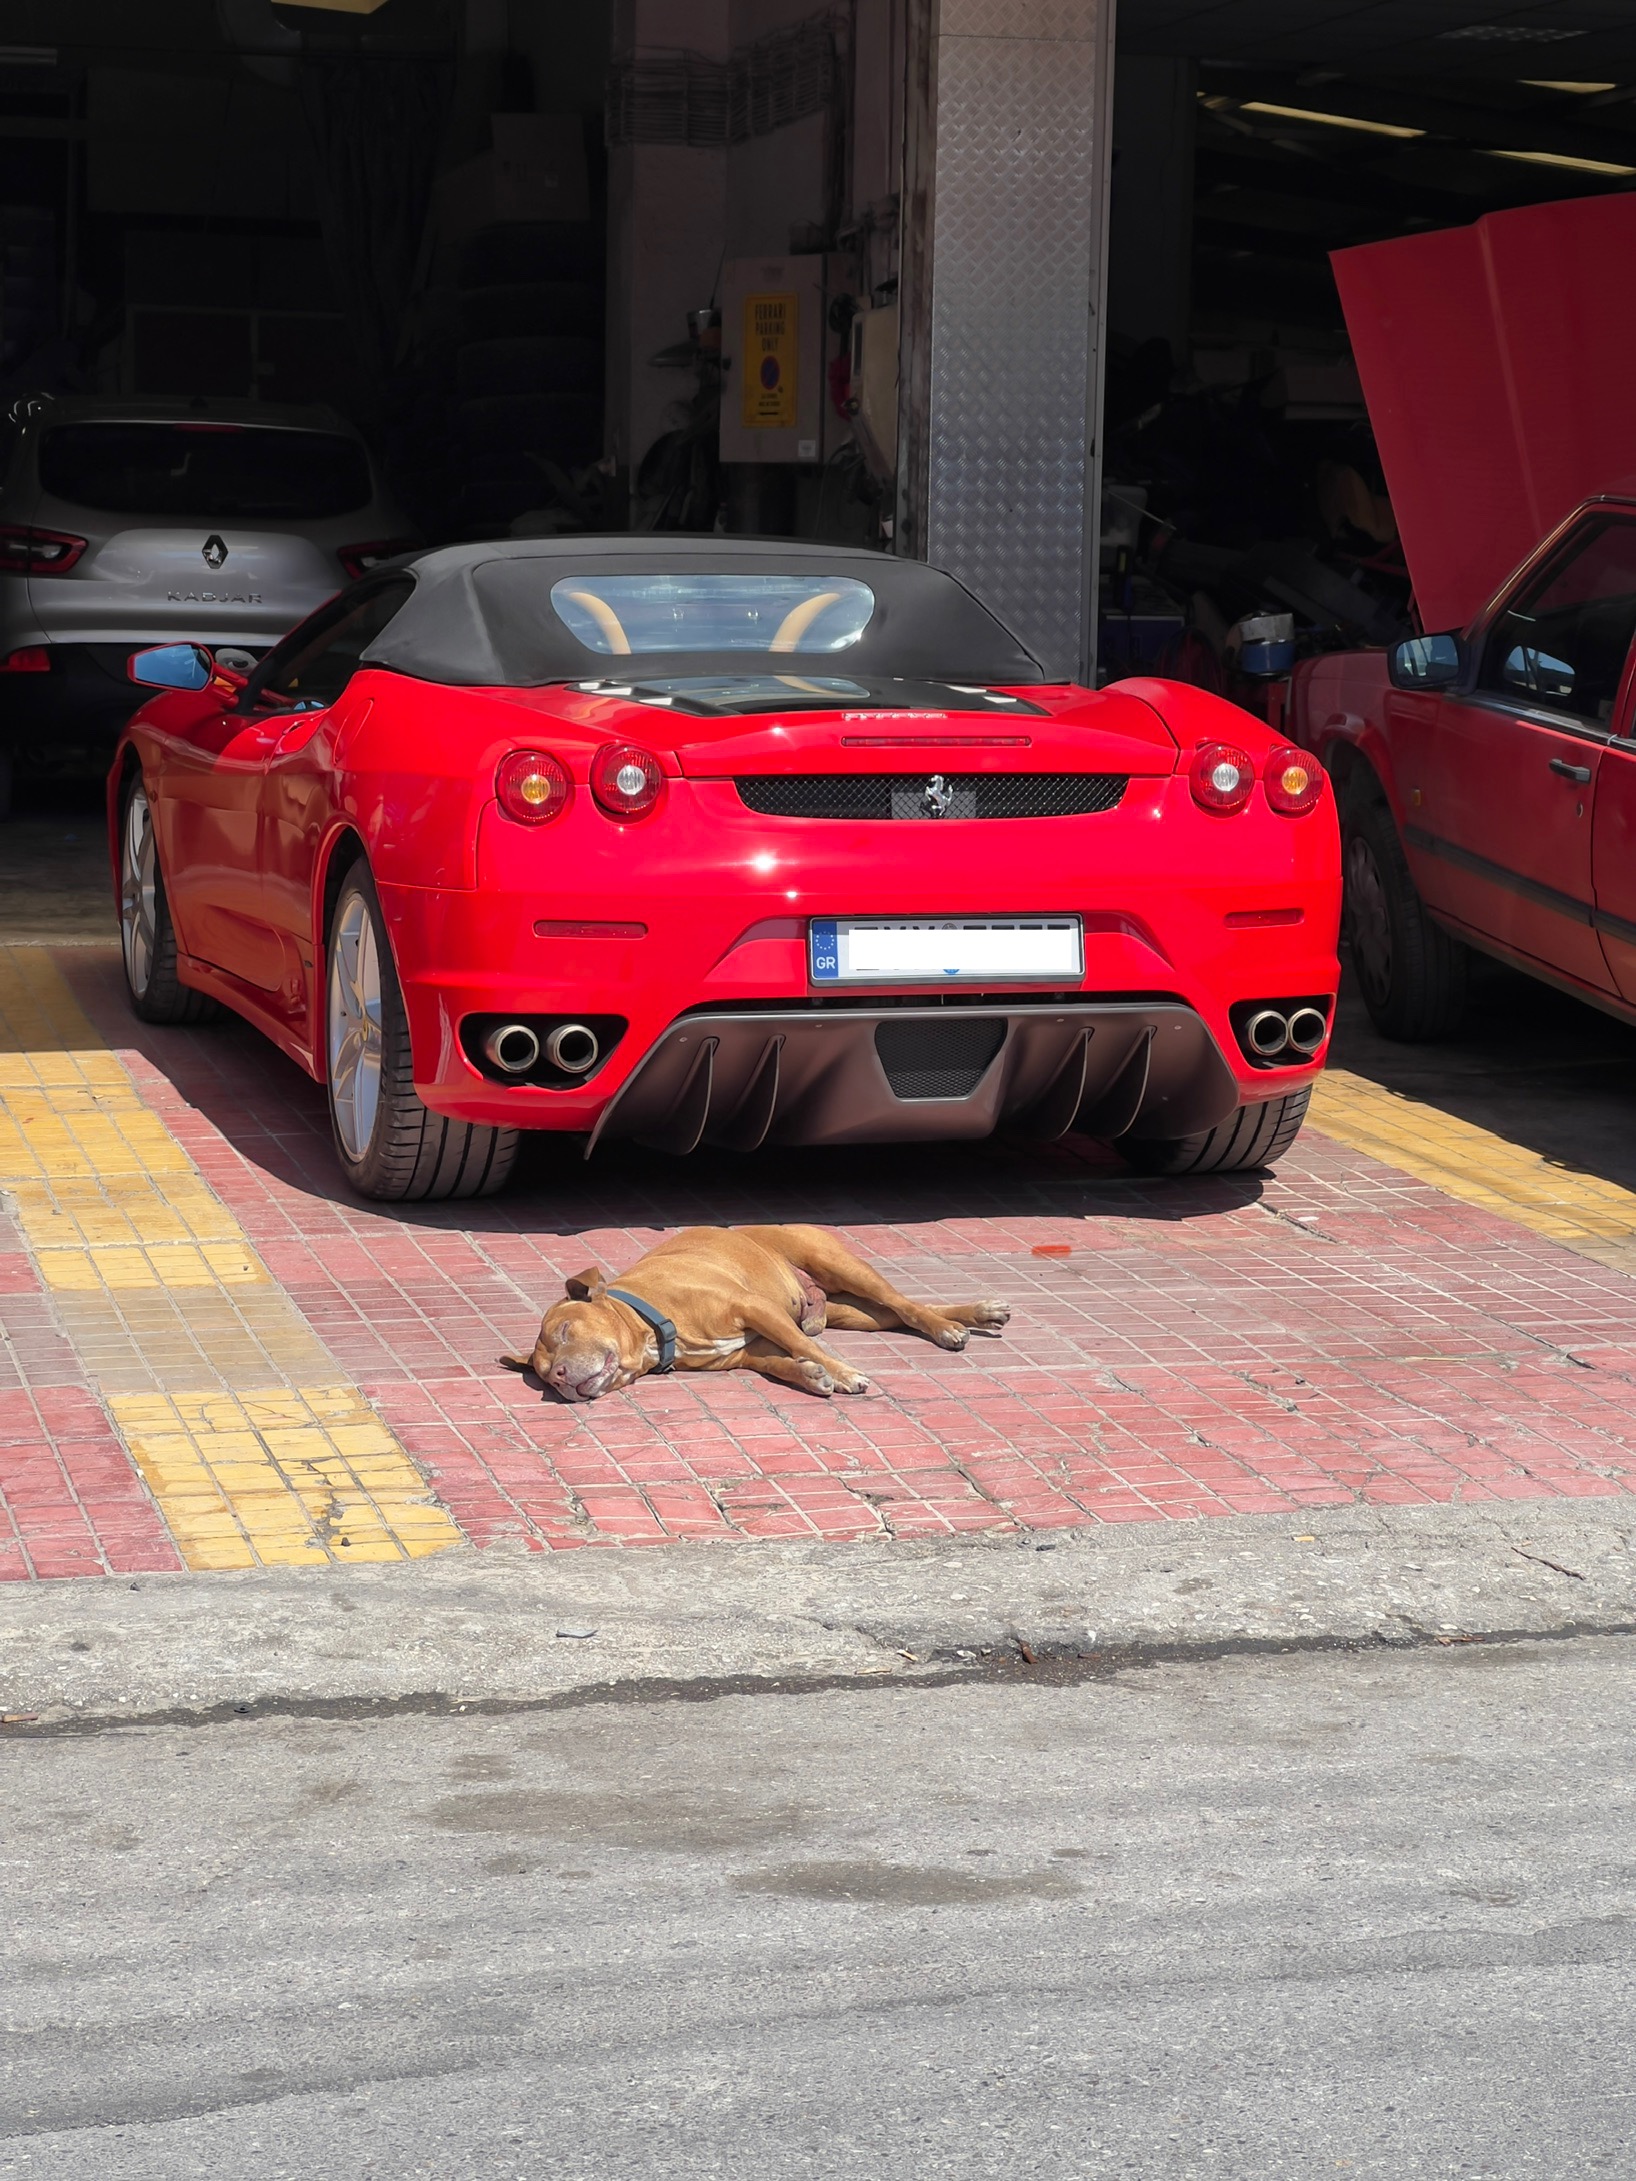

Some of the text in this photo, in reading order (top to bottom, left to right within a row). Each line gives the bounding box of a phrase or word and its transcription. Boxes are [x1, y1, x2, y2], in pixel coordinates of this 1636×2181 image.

[755, 303, 786, 320] FERRARI
[167, 591, 262, 604] KADJAR
[816, 956, 836, 970] GR
